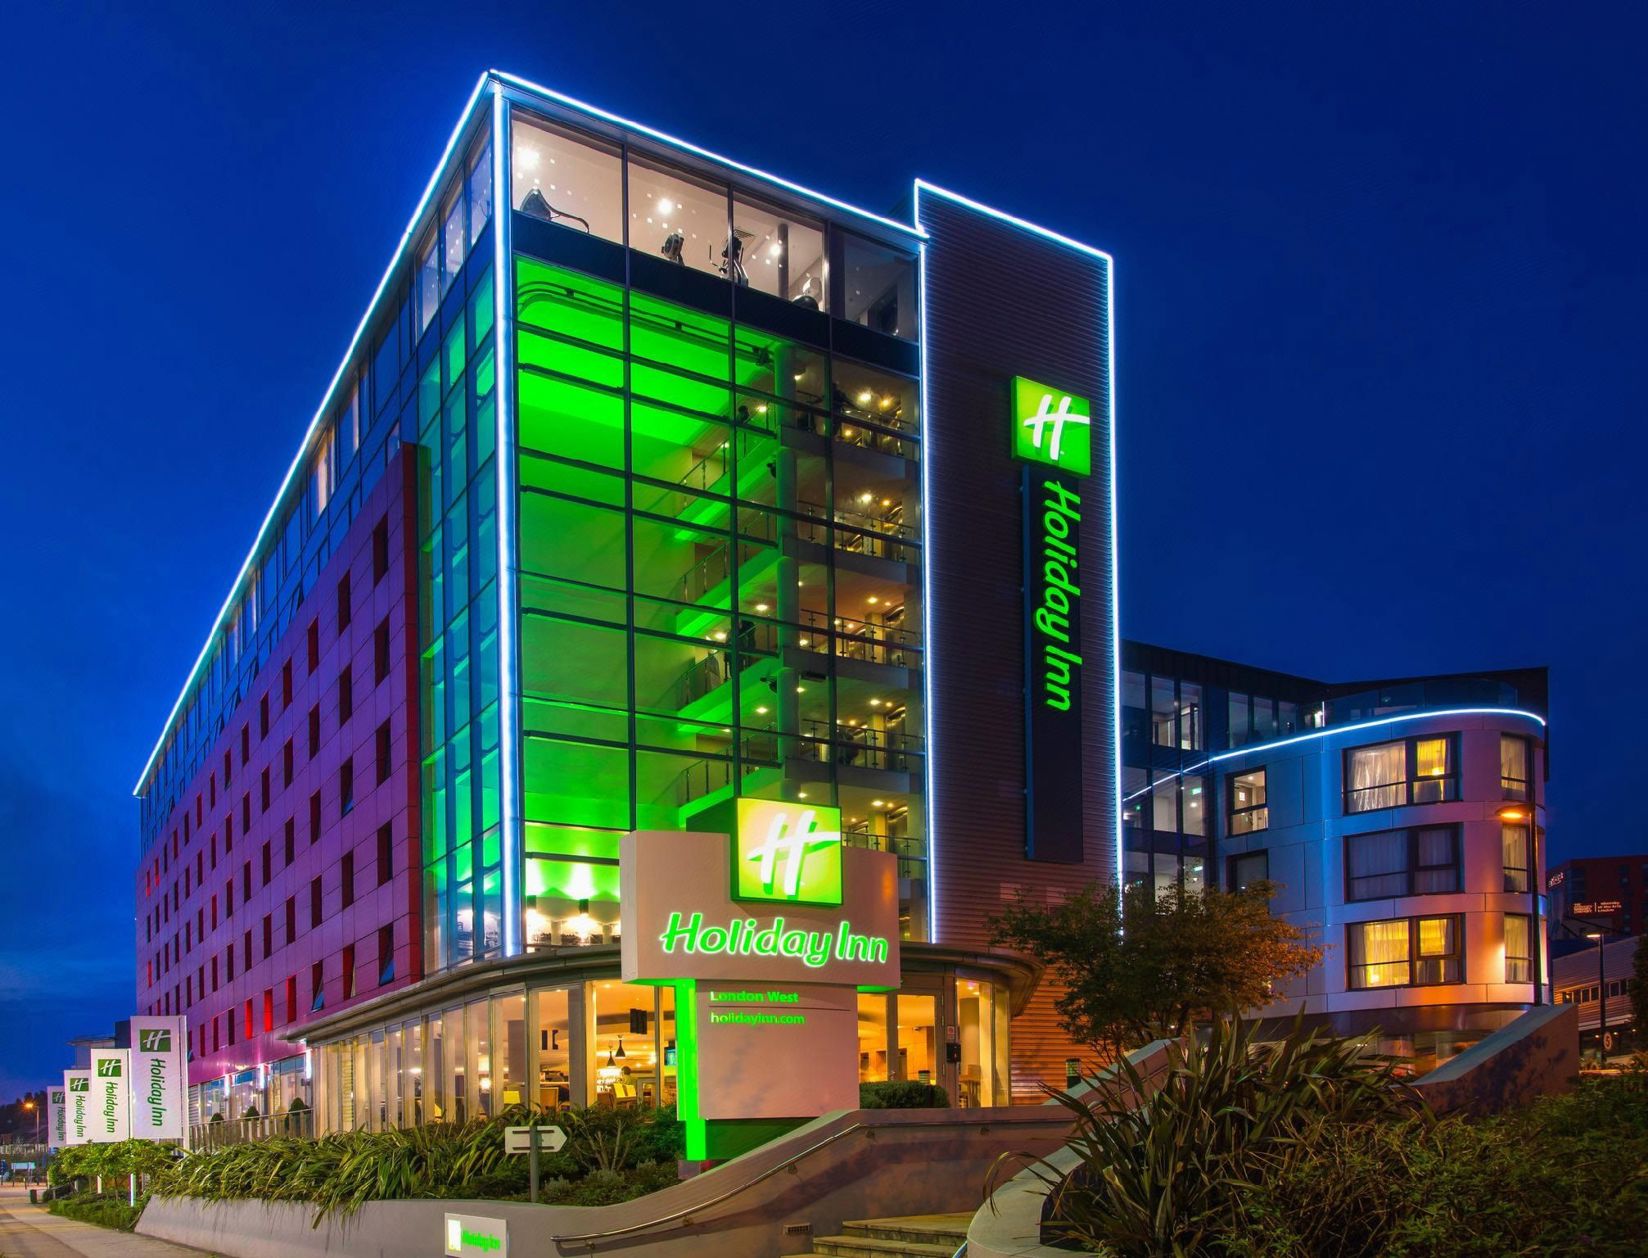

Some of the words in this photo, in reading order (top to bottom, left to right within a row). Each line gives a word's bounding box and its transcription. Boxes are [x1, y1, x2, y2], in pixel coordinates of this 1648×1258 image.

[1033, 480, 1081, 643] Holiday
[1046, 645, 1082, 711] Inn
[659, 911, 832, 967] Holiday
[836, 920, 889, 963] Inn
[710, 990, 764, 1002] London
[766, 991, 799, 1003] West
[710, 1011, 806, 1027] holidayinn.com
[147, 1058, 166, 1105] Holiday
[74, 1095, 86, 1125] Holiday
[103, 1081, 118, 1117] Holiday
[76, 1125, 87, 1138] Inn
[106, 1118, 118, 1133] Inn
[151, 1107, 167, 1127] Inn
